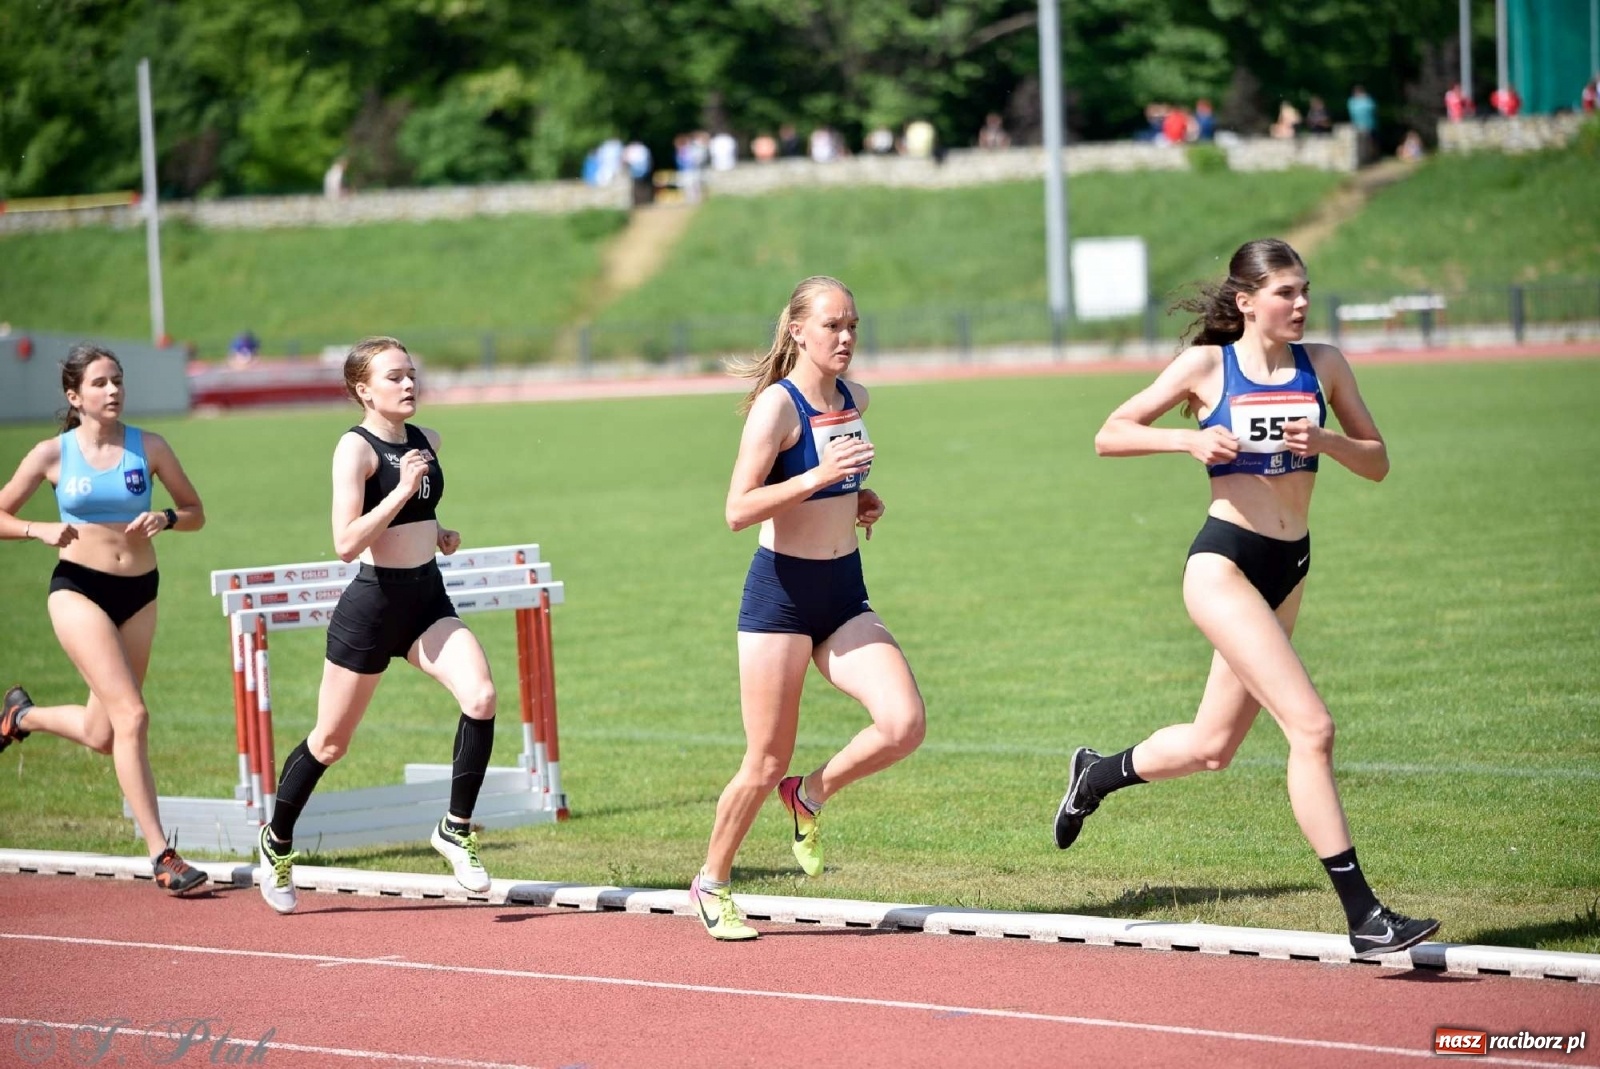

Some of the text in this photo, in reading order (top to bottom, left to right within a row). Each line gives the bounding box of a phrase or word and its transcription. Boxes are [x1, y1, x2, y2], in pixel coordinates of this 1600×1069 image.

[1249, 416, 1307, 441] 55
[64, 476, 92, 496] 46
[302, 570, 328, 579] ORLEN
